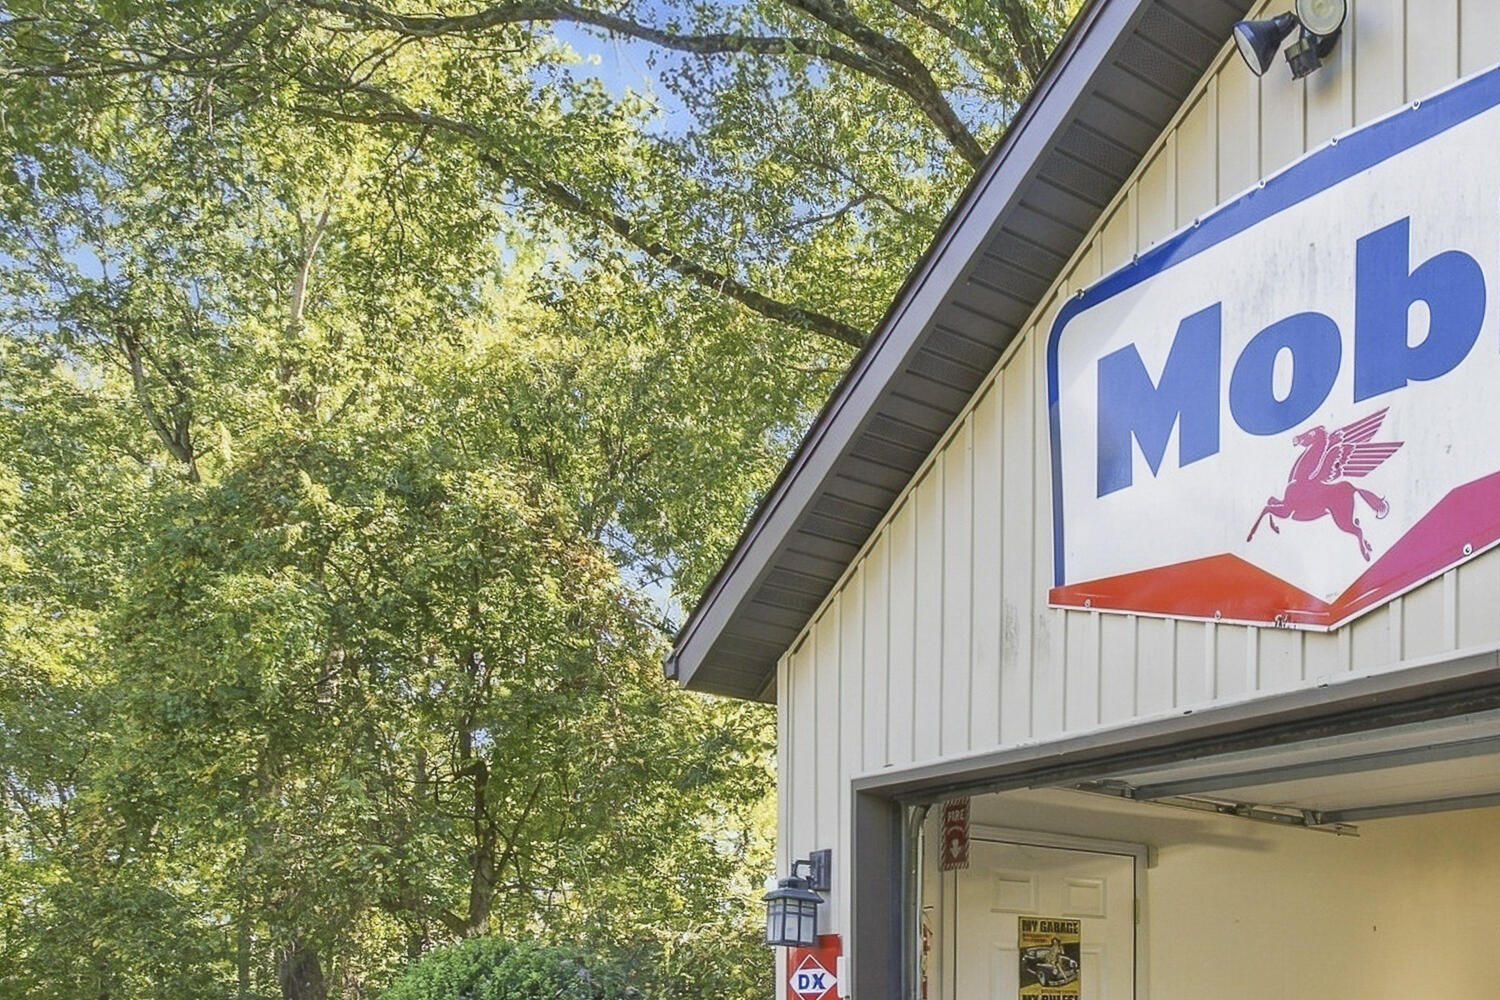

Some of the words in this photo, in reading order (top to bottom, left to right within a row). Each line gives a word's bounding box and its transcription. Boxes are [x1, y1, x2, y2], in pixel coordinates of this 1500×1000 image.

[947, 808, 966, 822] FIRE
[1022, 920, 1038, 932] MY
[1040, 920, 1079, 934] GARAGE
[798, 973, 826, 990] DX
